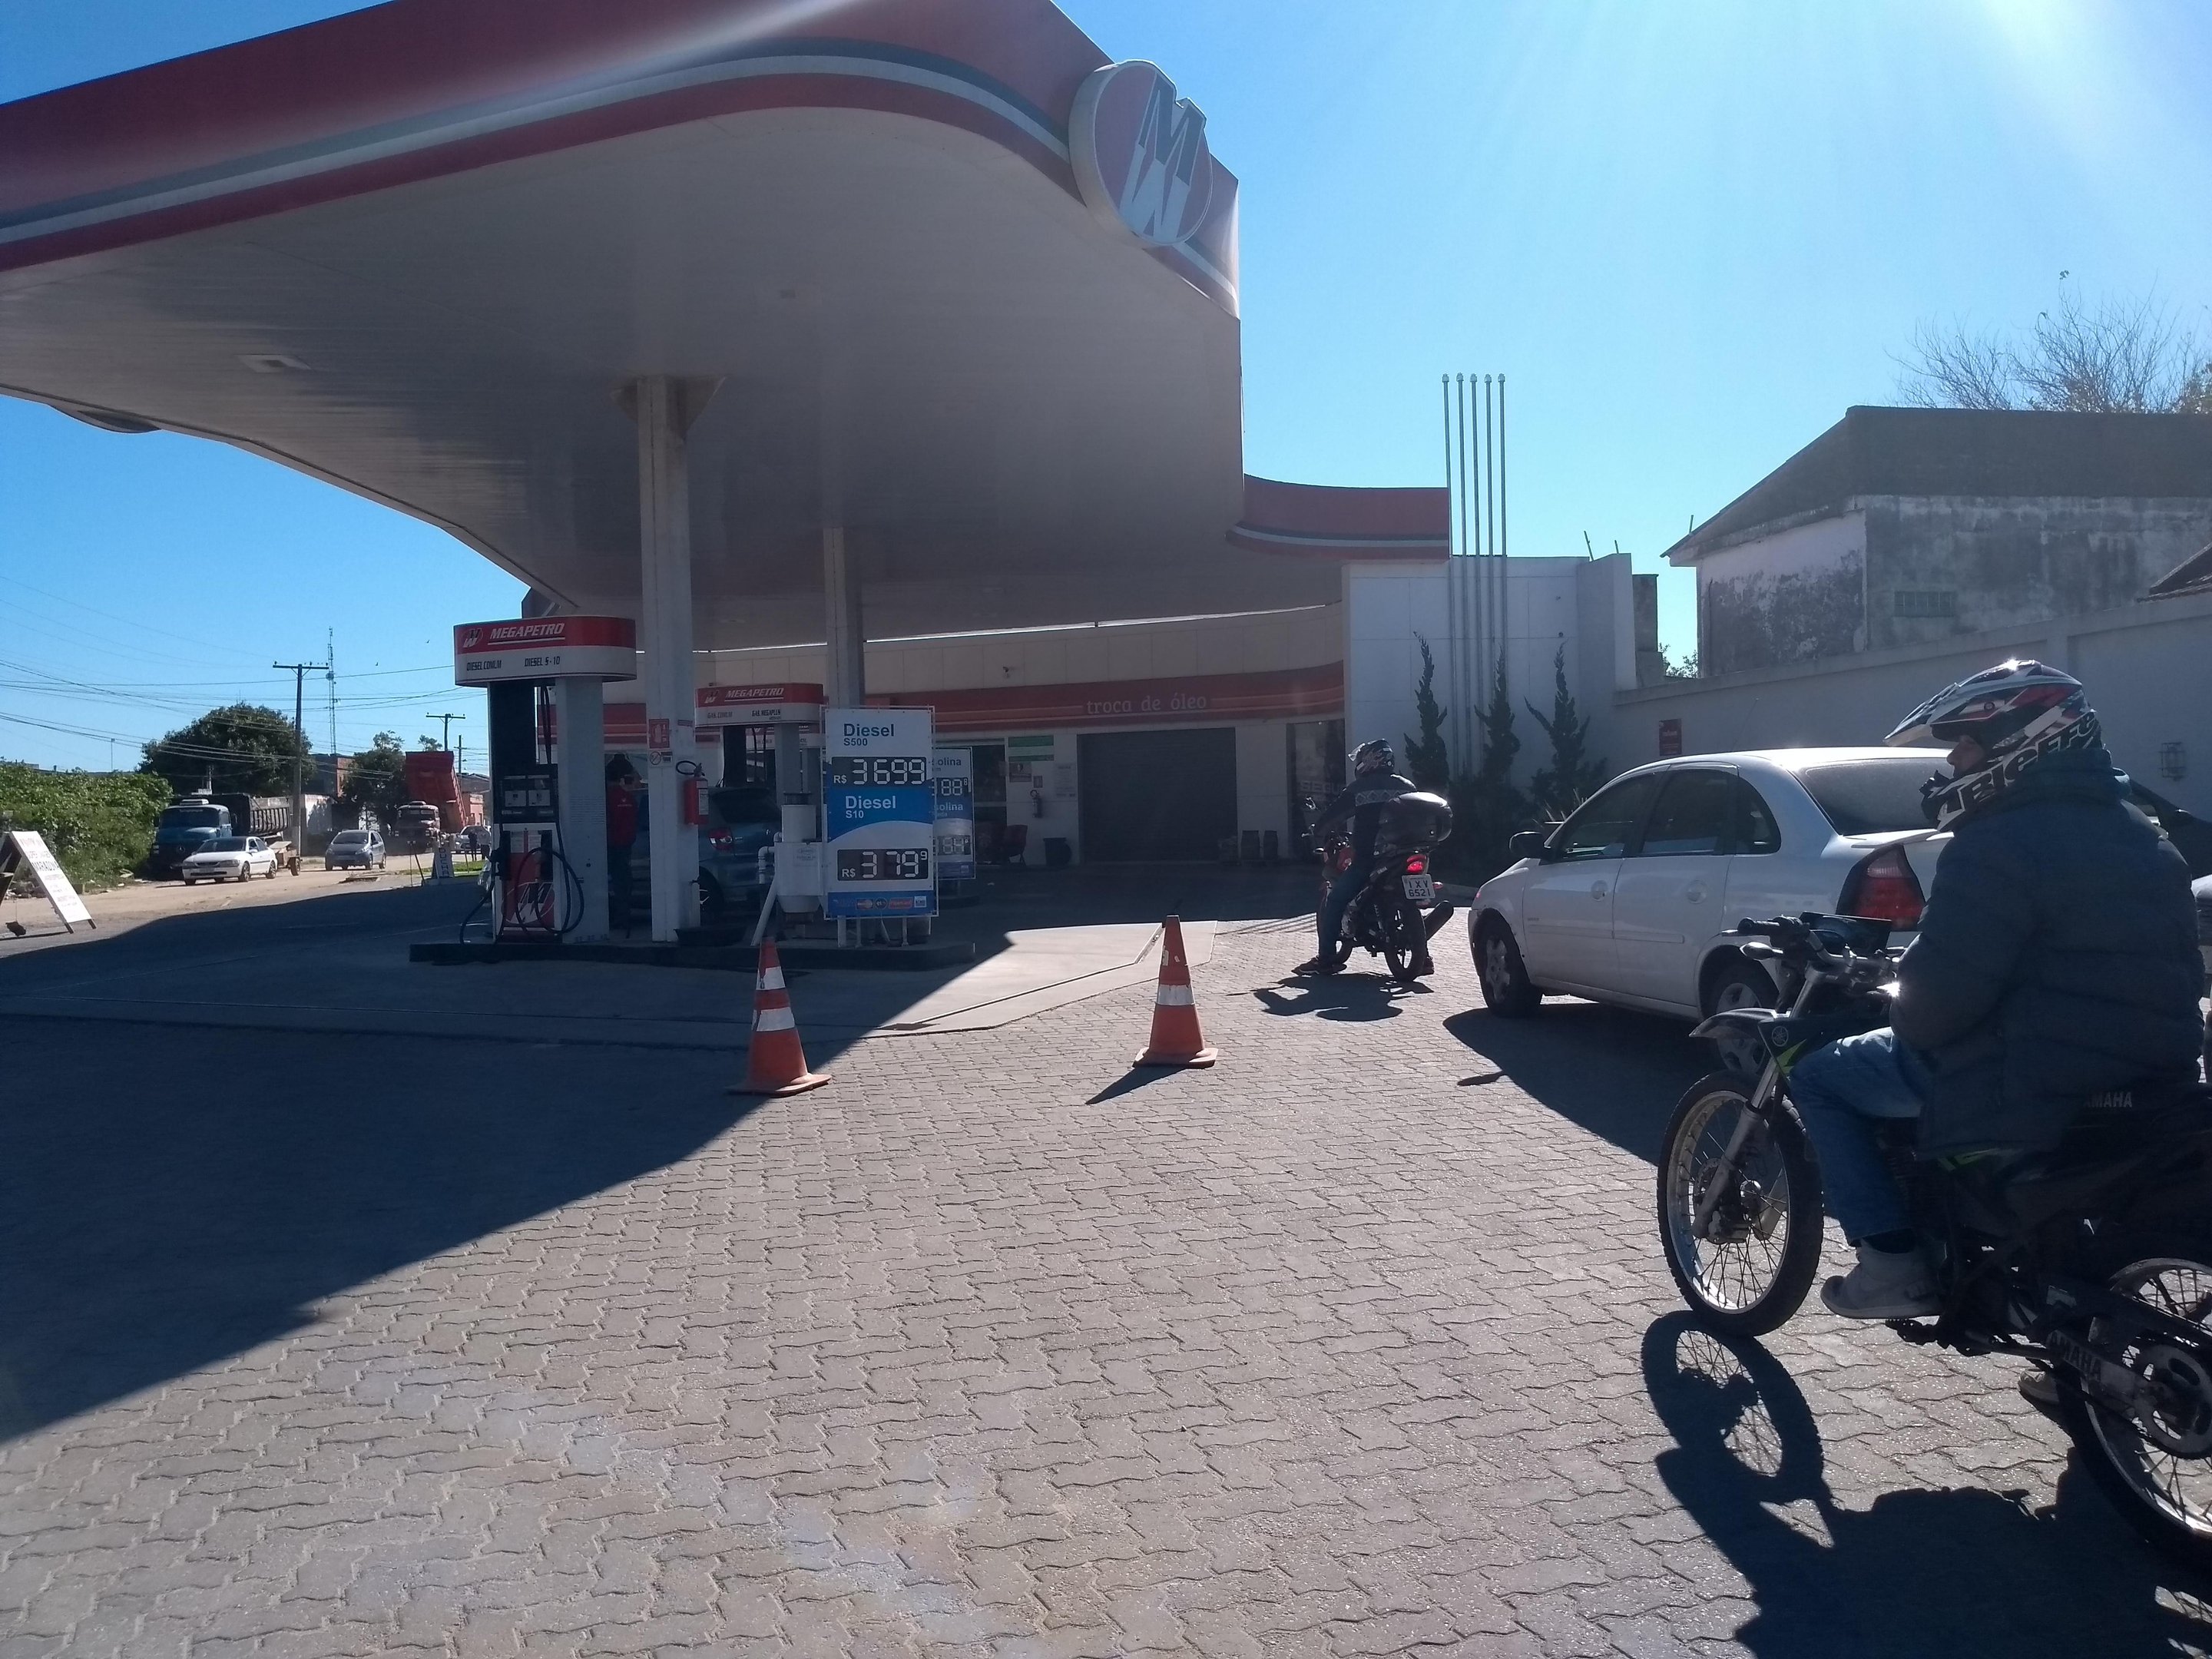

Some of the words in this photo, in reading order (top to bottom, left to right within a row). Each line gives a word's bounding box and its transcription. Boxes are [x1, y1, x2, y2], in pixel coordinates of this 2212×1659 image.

[490, 623, 565, 639] MEGAPETRO
[467, 661, 482, 671] DIESEL
[525, 657, 543, 667] DIESEL
[726, 687, 784, 697] MEGAPETRO
[1087, 700, 1131, 714] troca
[1141, 695, 1161, 711] de
[1171, 692, 1207, 710] óleo
[843, 723, 894, 737] Diesel
[843, 738, 868, 747] S500
[932, 757, 962, 766] olina
[833, 775, 847, 784] R$
[853, 759, 925, 785] 3699
[845, 795, 896, 809] Diesel
[846, 810, 864, 819] S10
[842, 869, 856, 878] R$
[1409, 889, 1431, 897] 6521
[2083, 1091, 2133, 1108] MAHA
